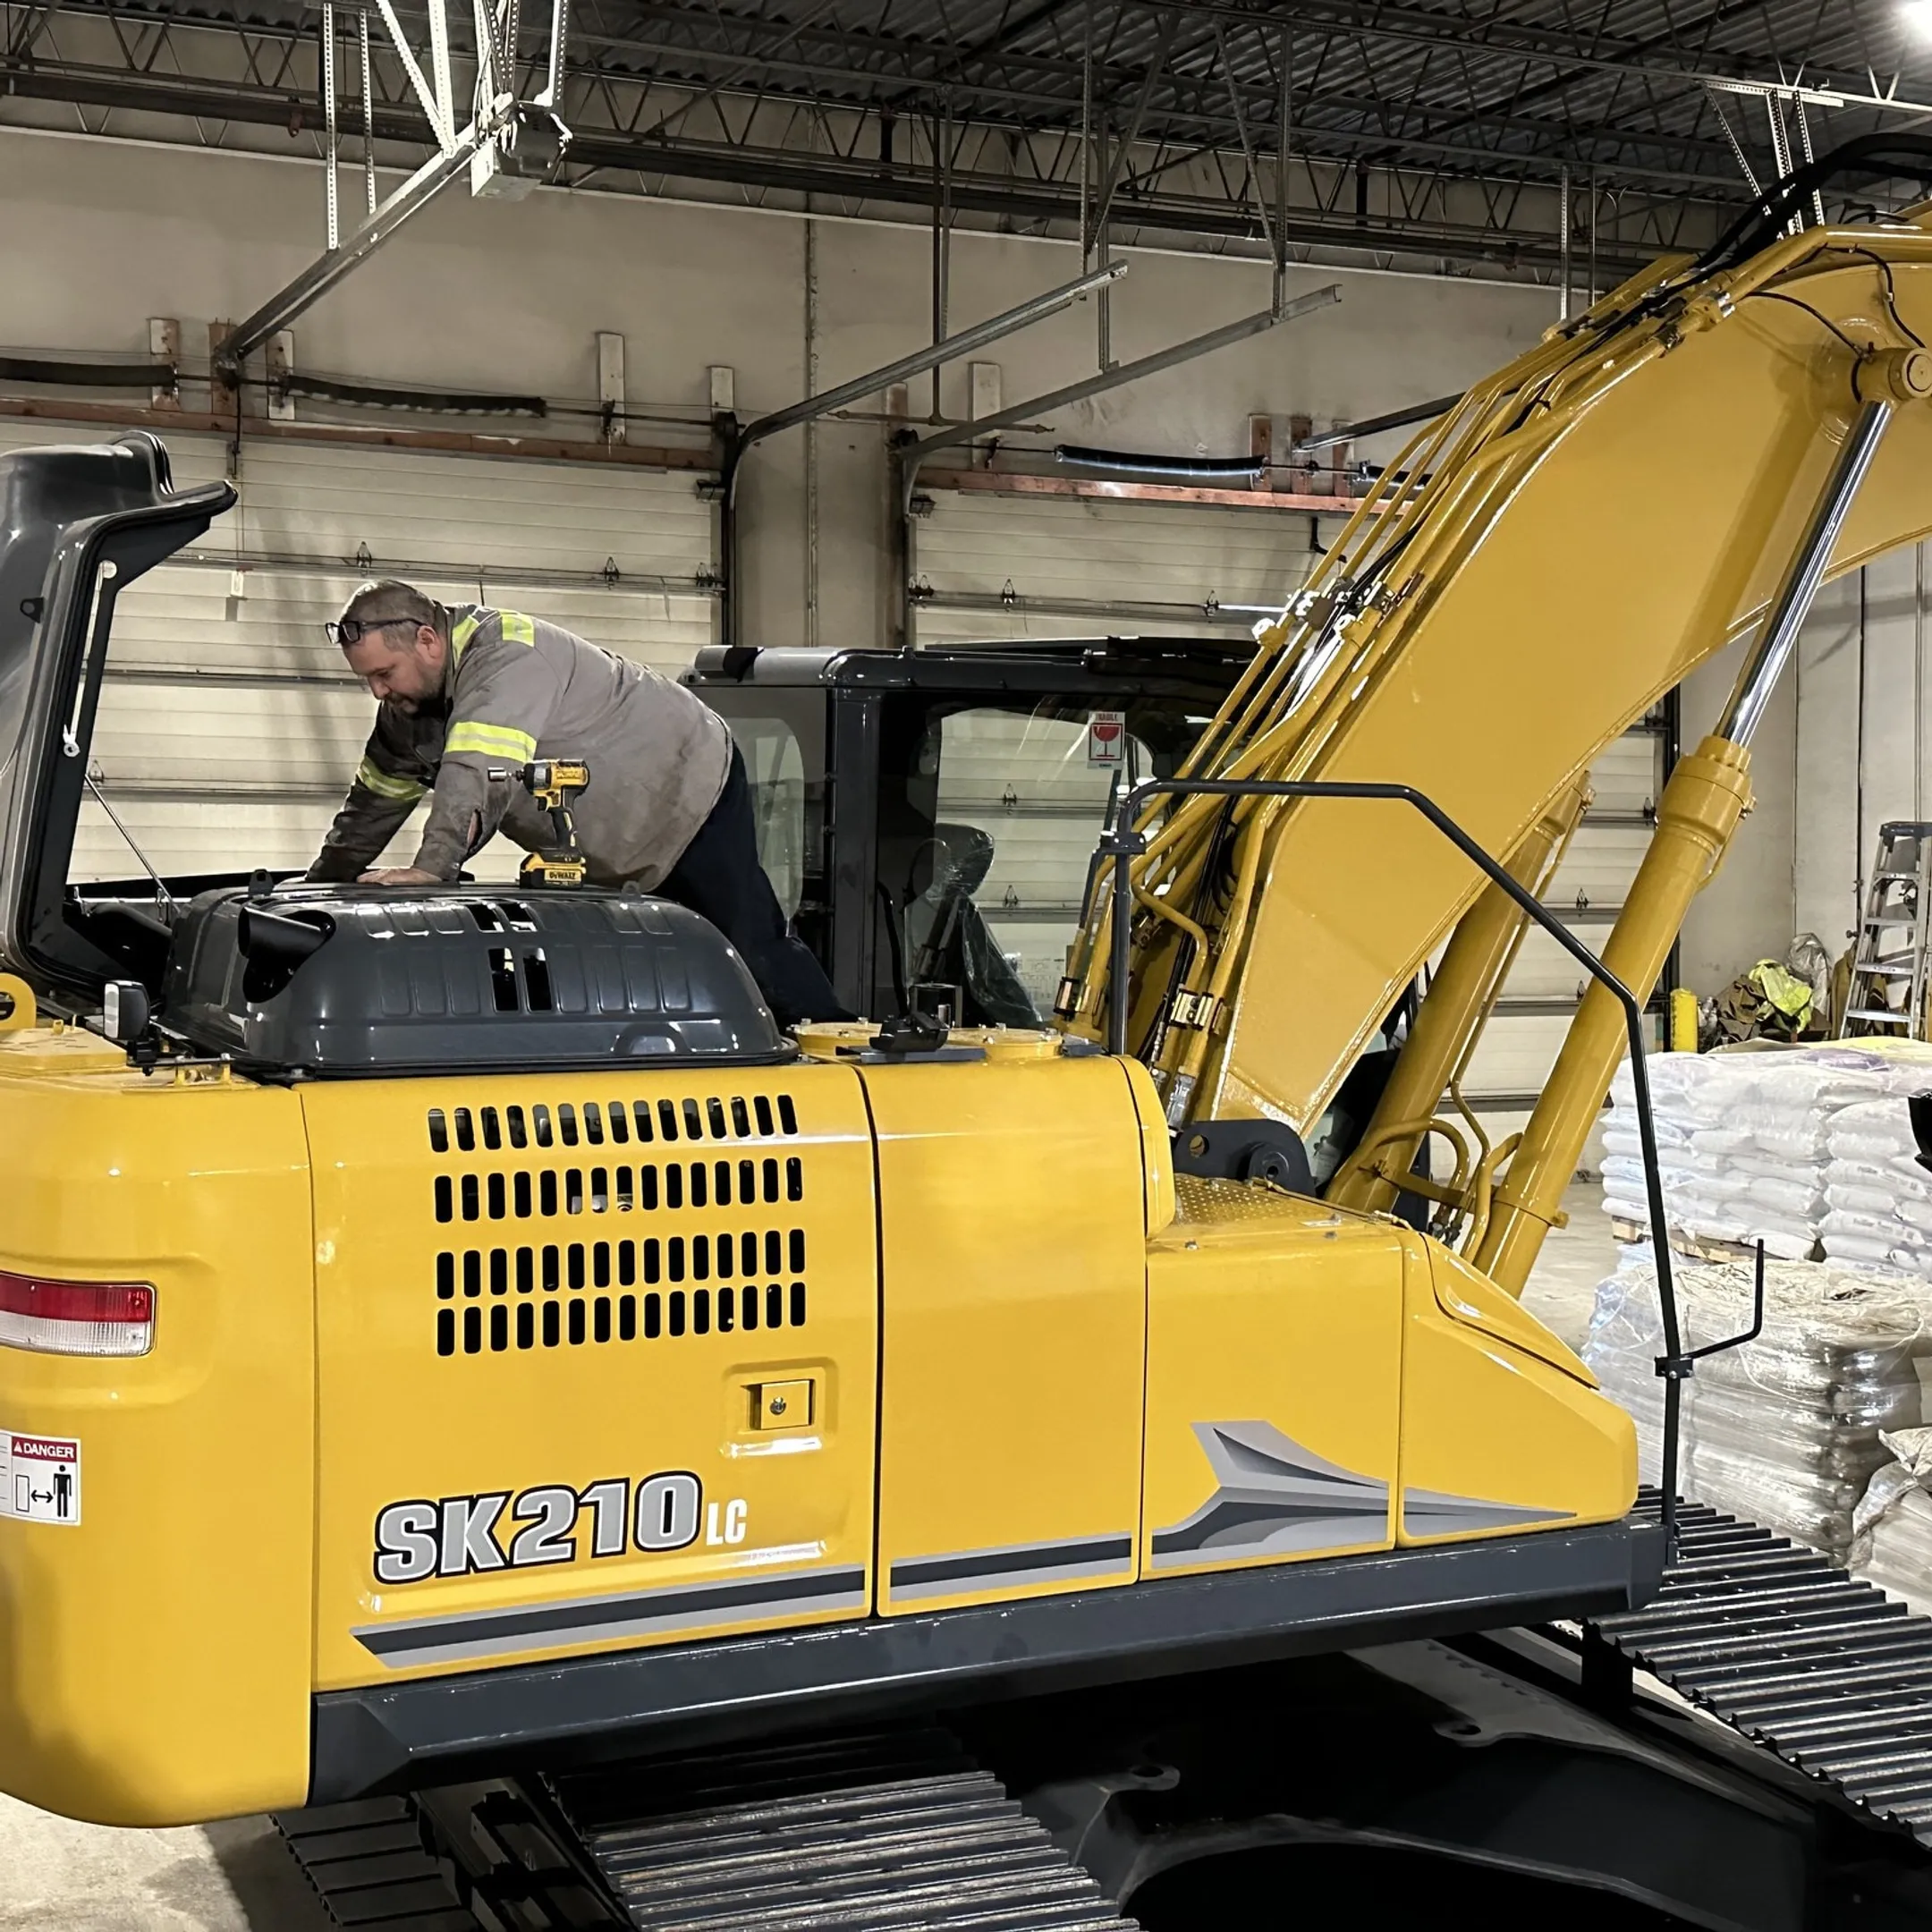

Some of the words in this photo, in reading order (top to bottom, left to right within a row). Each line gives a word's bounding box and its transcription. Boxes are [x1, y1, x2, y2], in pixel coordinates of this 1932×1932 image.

[23, 1443, 74, 1458] DANGER
[374, 1470, 702, 1584] SK210
[706, 1499, 748, 1546] LC
